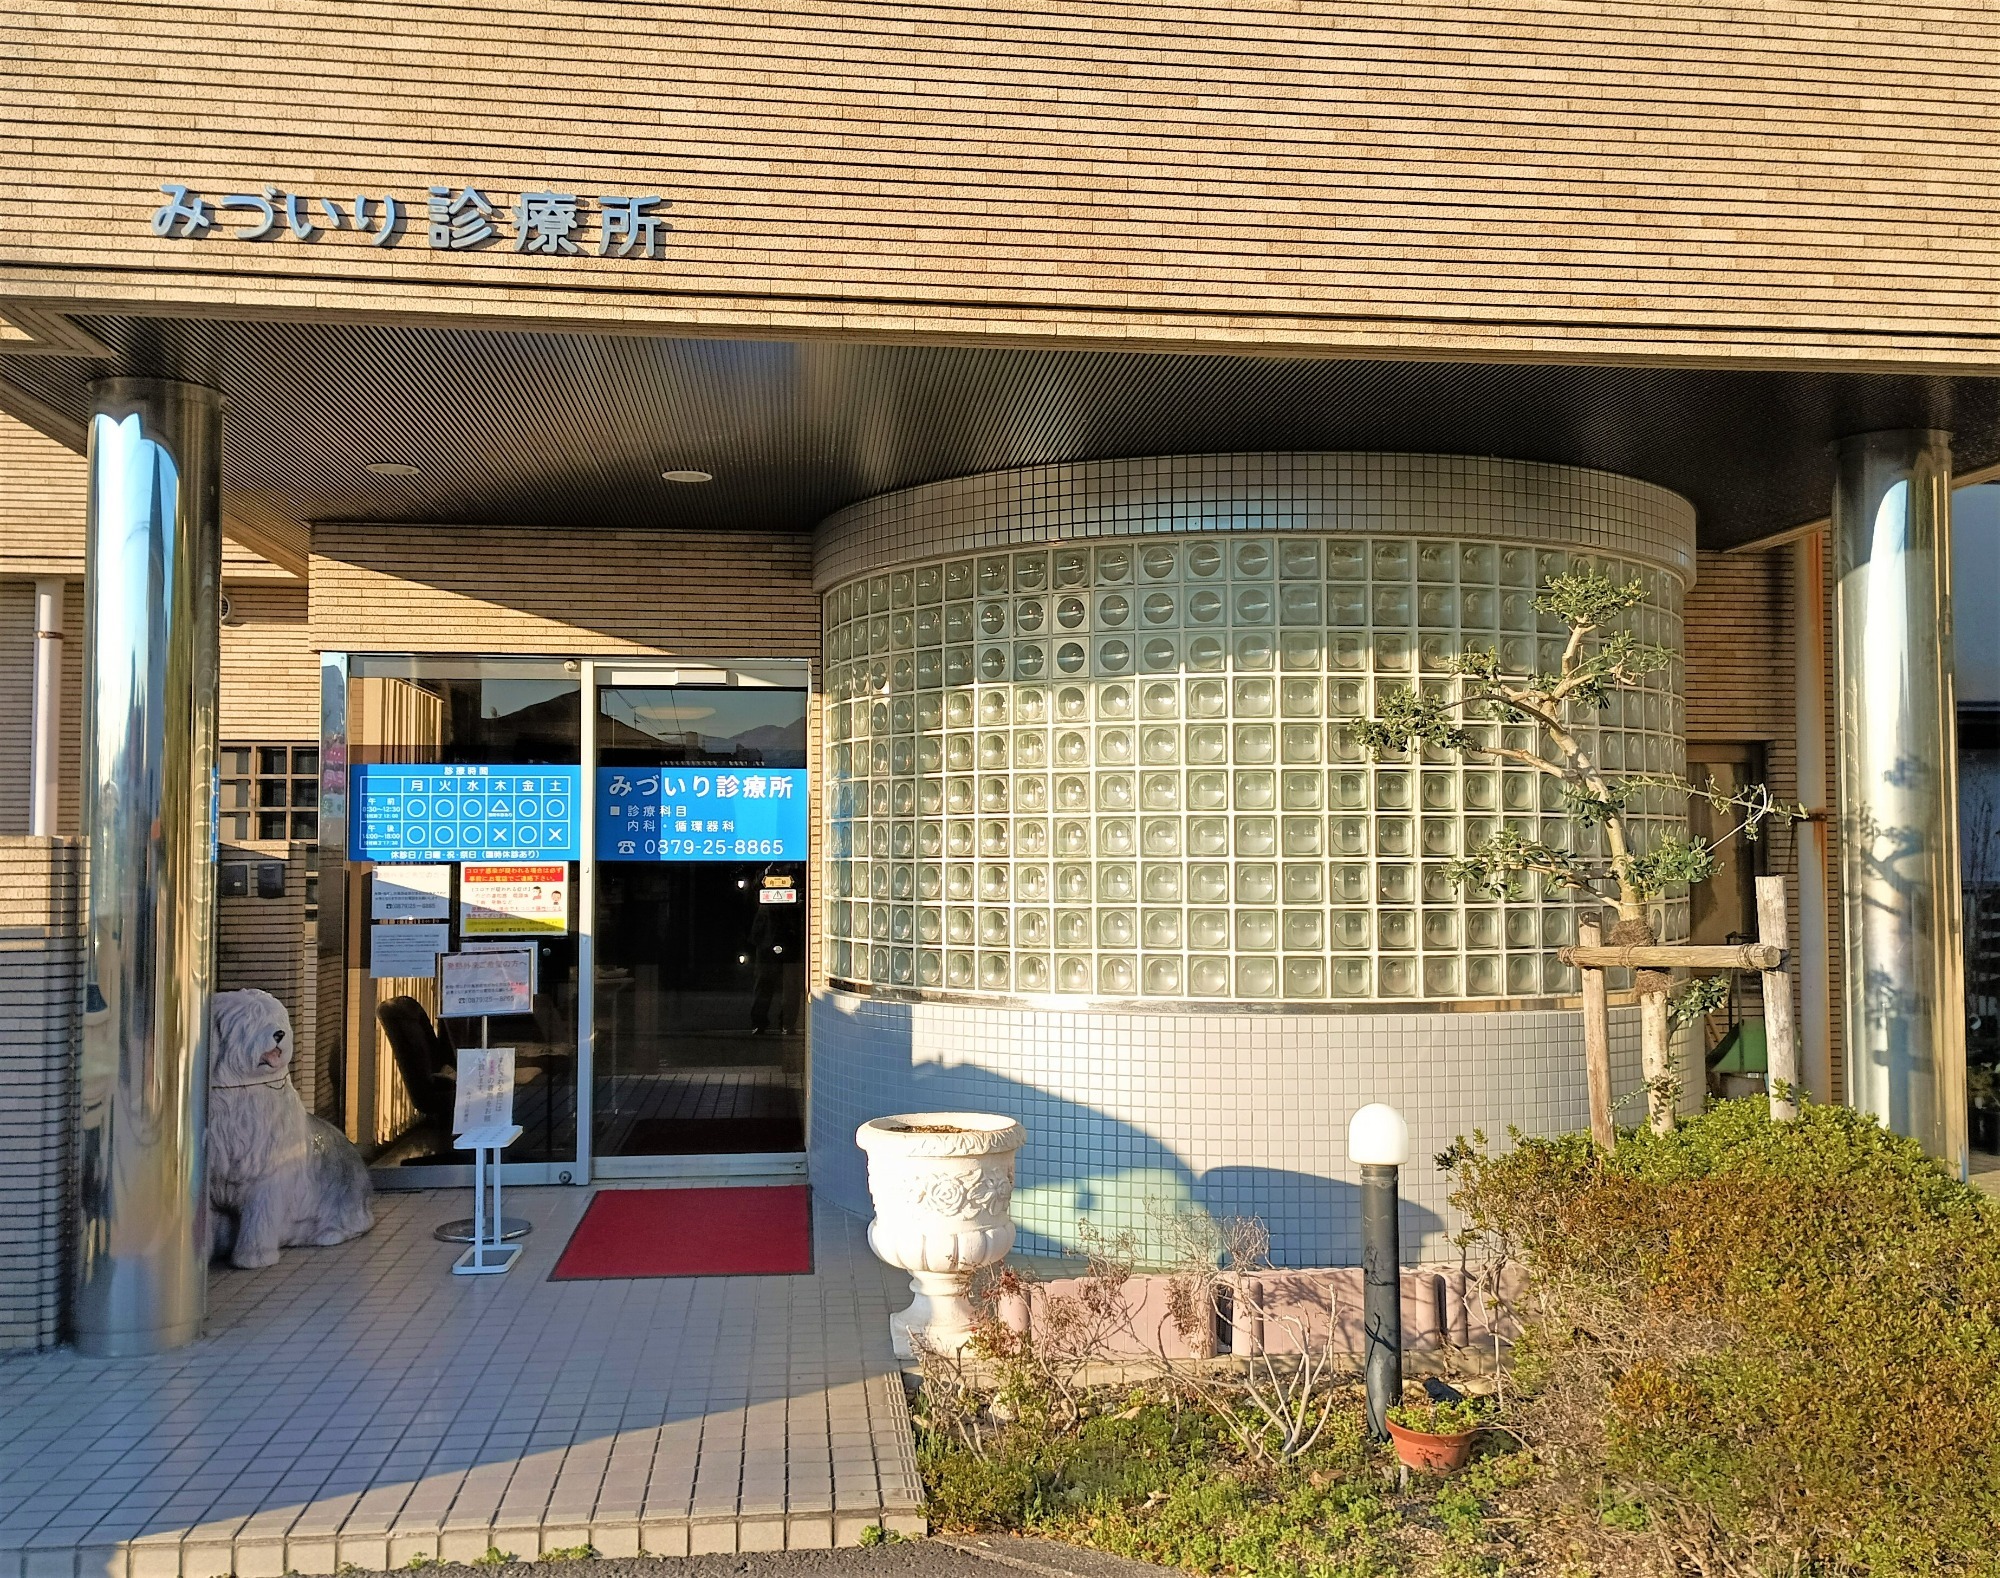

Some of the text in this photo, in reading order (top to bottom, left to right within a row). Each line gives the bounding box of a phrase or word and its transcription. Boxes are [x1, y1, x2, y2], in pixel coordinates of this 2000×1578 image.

[152, 184, 661, 257] みづいり診療所
[444, 766, 489, 775] 診療時間
[410, 781, 562, 792] 月 火 水 木 金 土
[609, 775, 793, 799] みづいり診療所
[627, 805, 687, 817] 診療科目
[627, 820, 735, 832] 内科・循環器科
[644, 839, 784, 855] 0879-25-8865
